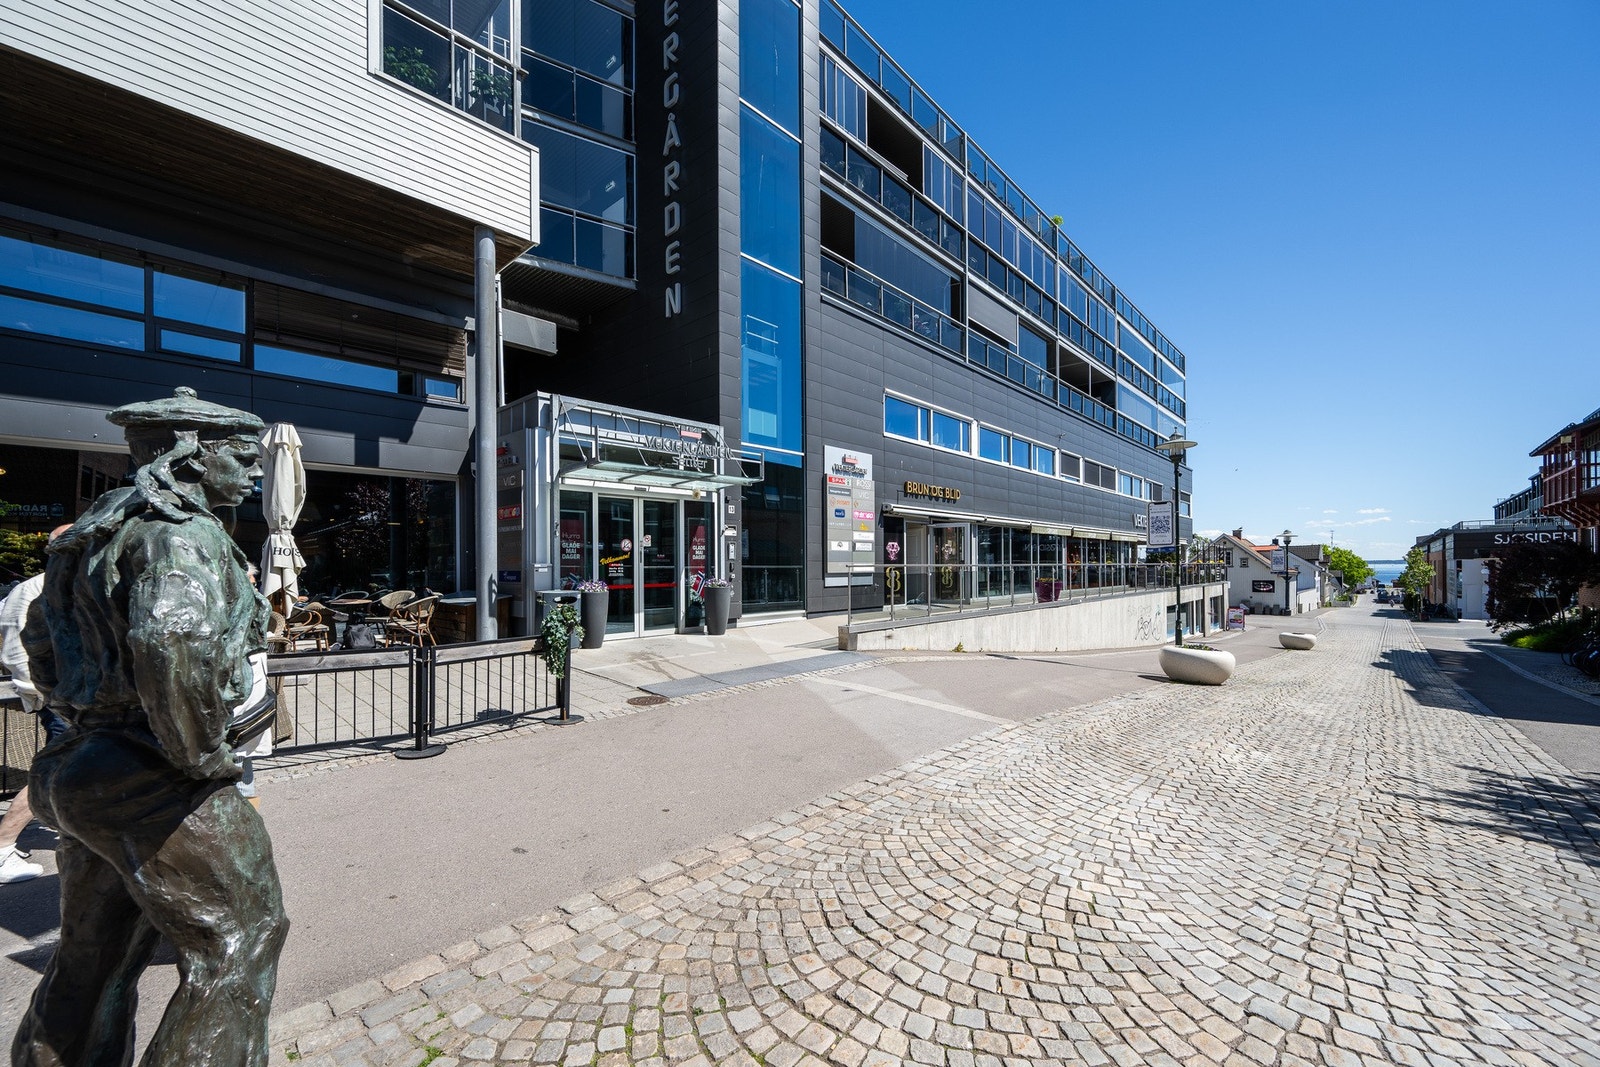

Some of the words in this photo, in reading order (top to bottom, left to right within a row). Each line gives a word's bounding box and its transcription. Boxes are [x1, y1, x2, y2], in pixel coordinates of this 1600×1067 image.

[906, 481, 929, 495] BRUN
[931, 485, 944, 497] OG
[945, 487, 962, 500] BLID
